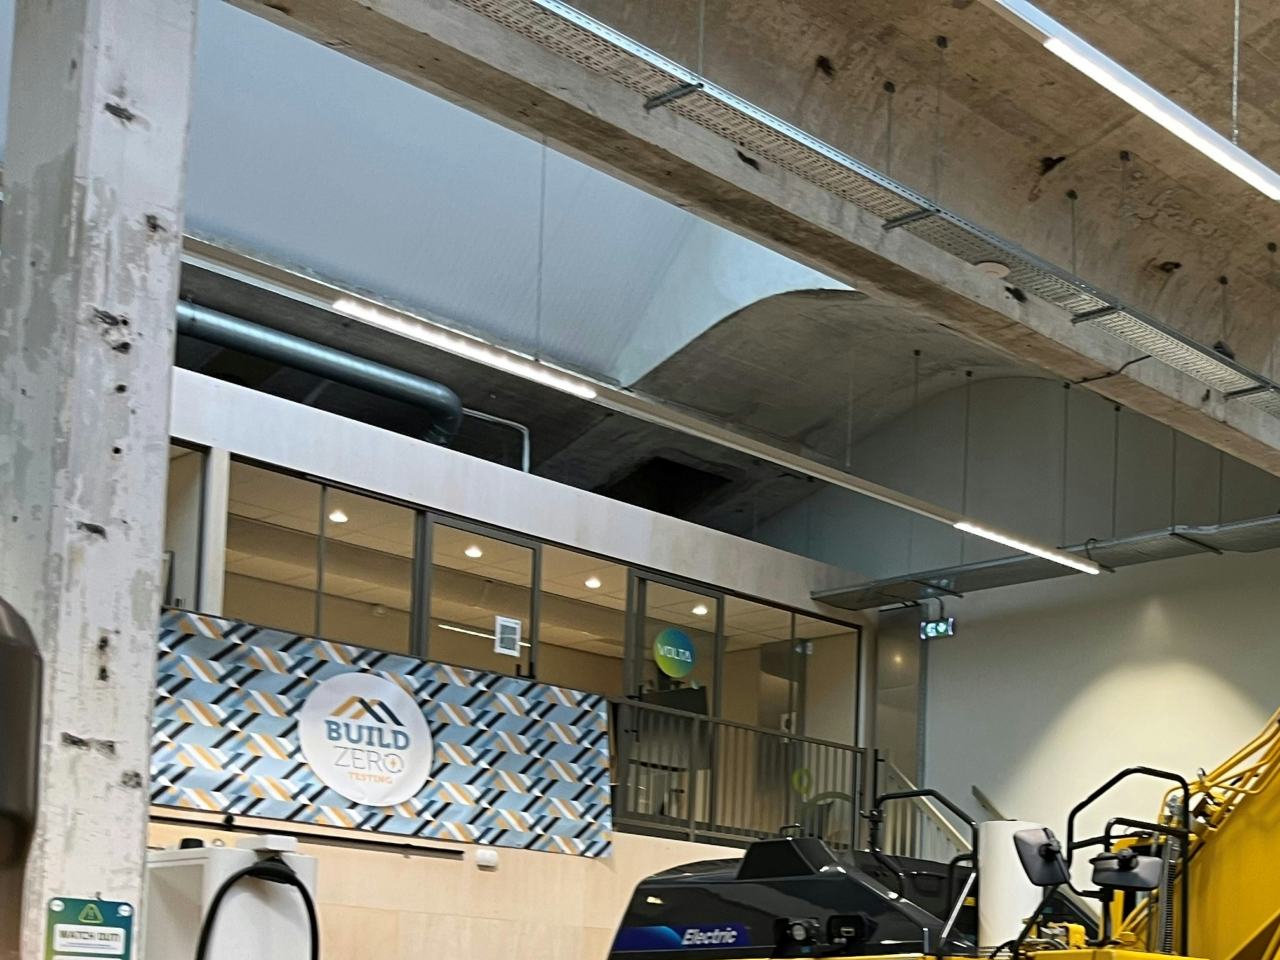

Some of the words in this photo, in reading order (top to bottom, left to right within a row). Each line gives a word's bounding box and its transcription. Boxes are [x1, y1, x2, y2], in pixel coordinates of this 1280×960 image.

[325, 719, 410, 750] BUILD
[334, 745, 404, 773] ZERO
[350, 772, 393, 784] TESTING
[682, 927, 738, 945] Electric
